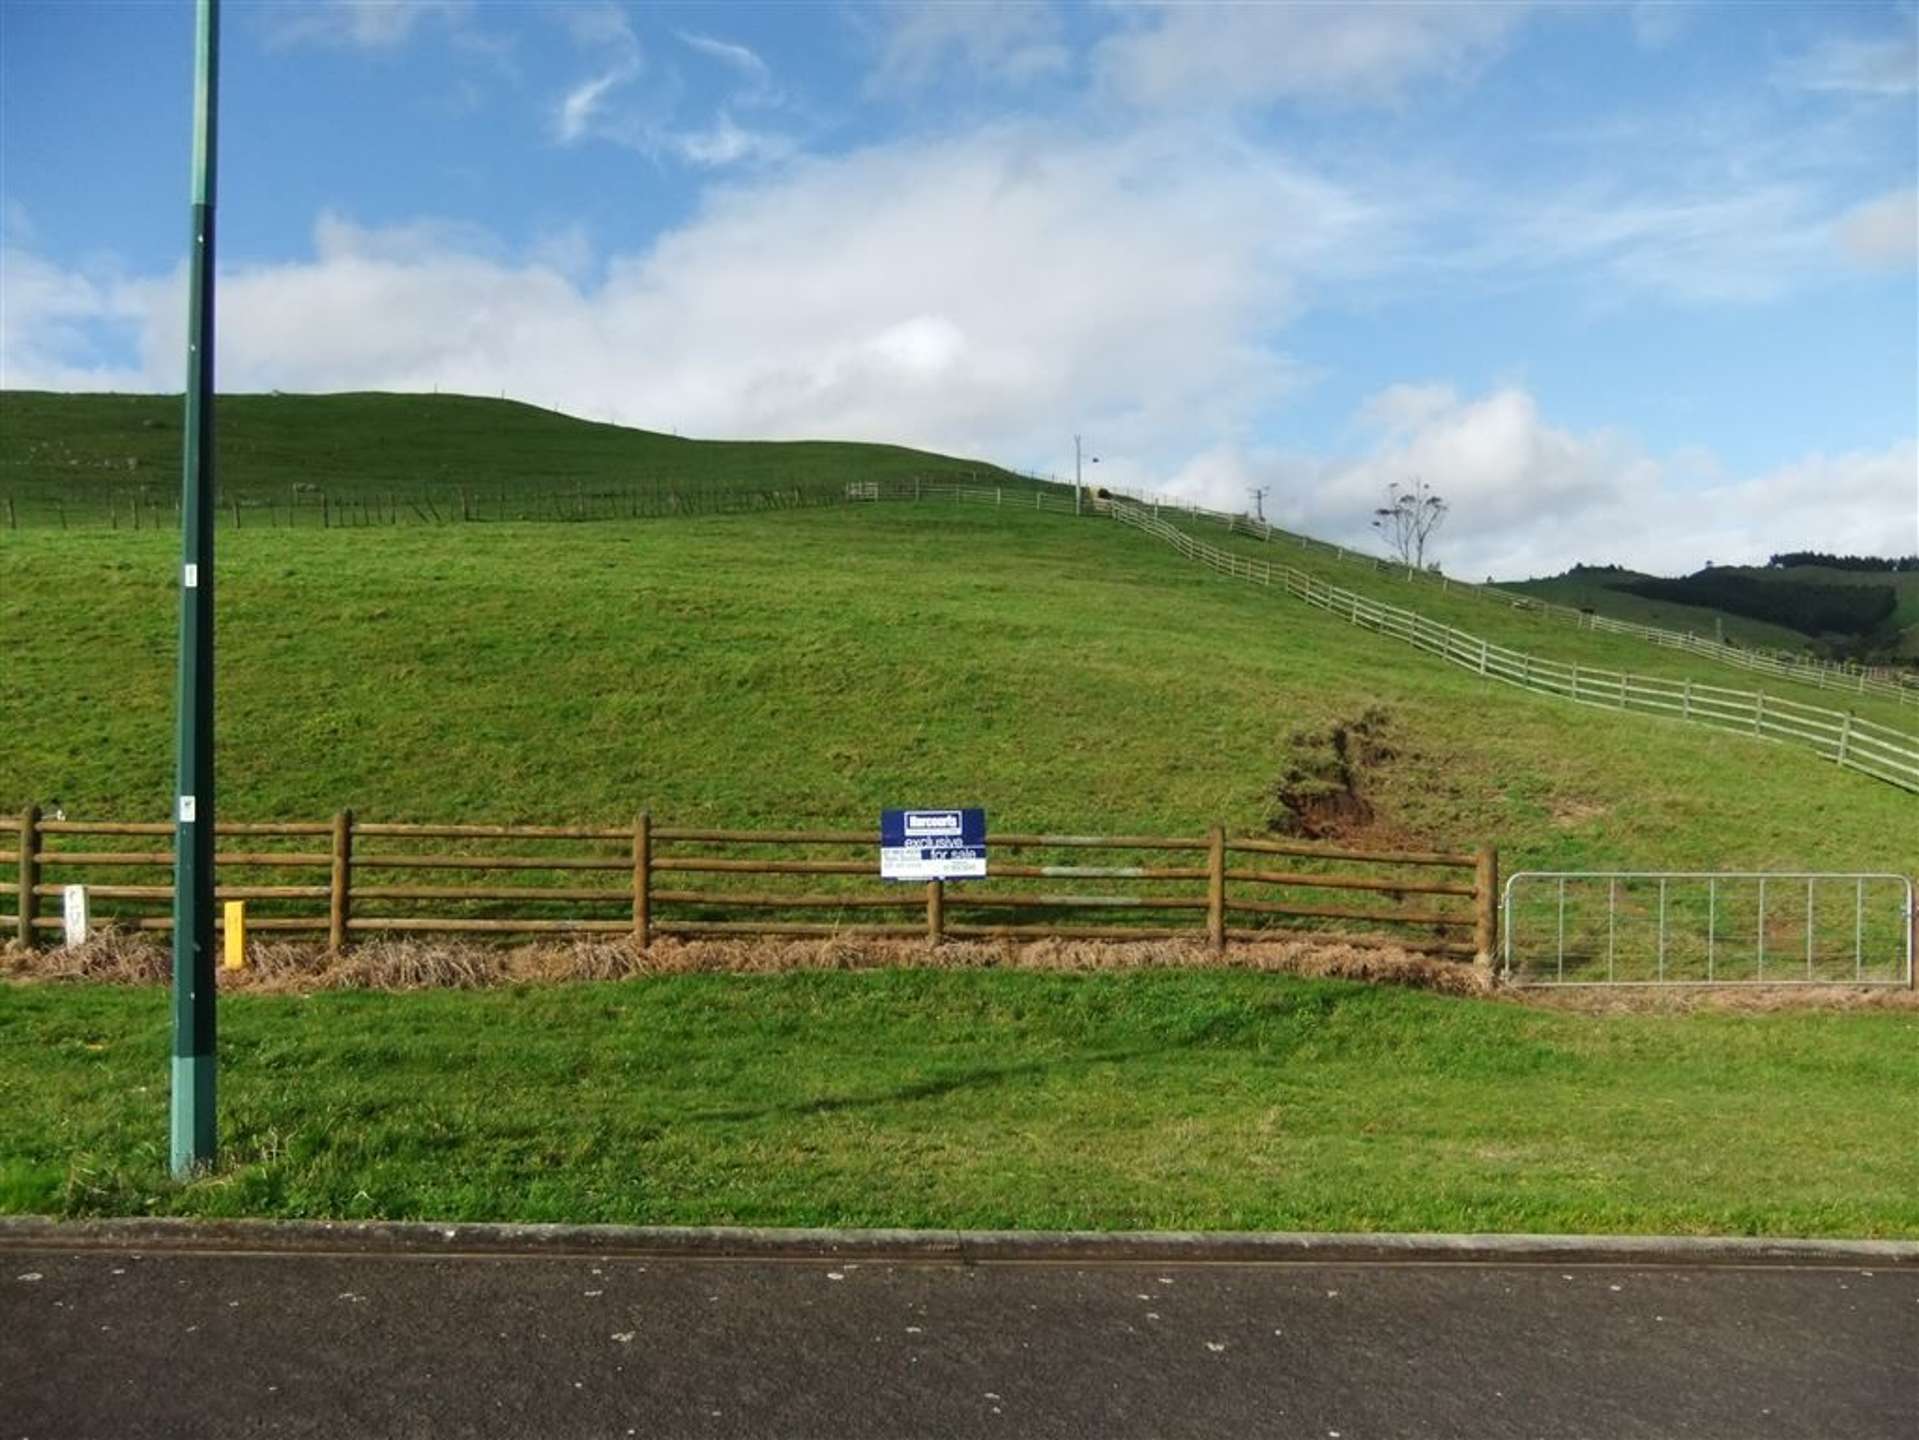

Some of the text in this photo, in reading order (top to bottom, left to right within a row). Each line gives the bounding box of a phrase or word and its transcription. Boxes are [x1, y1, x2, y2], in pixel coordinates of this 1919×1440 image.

[904, 836, 963, 848] exclusive
[931, 849, 948, 860] for
[951, 849, 976, 860] sale
